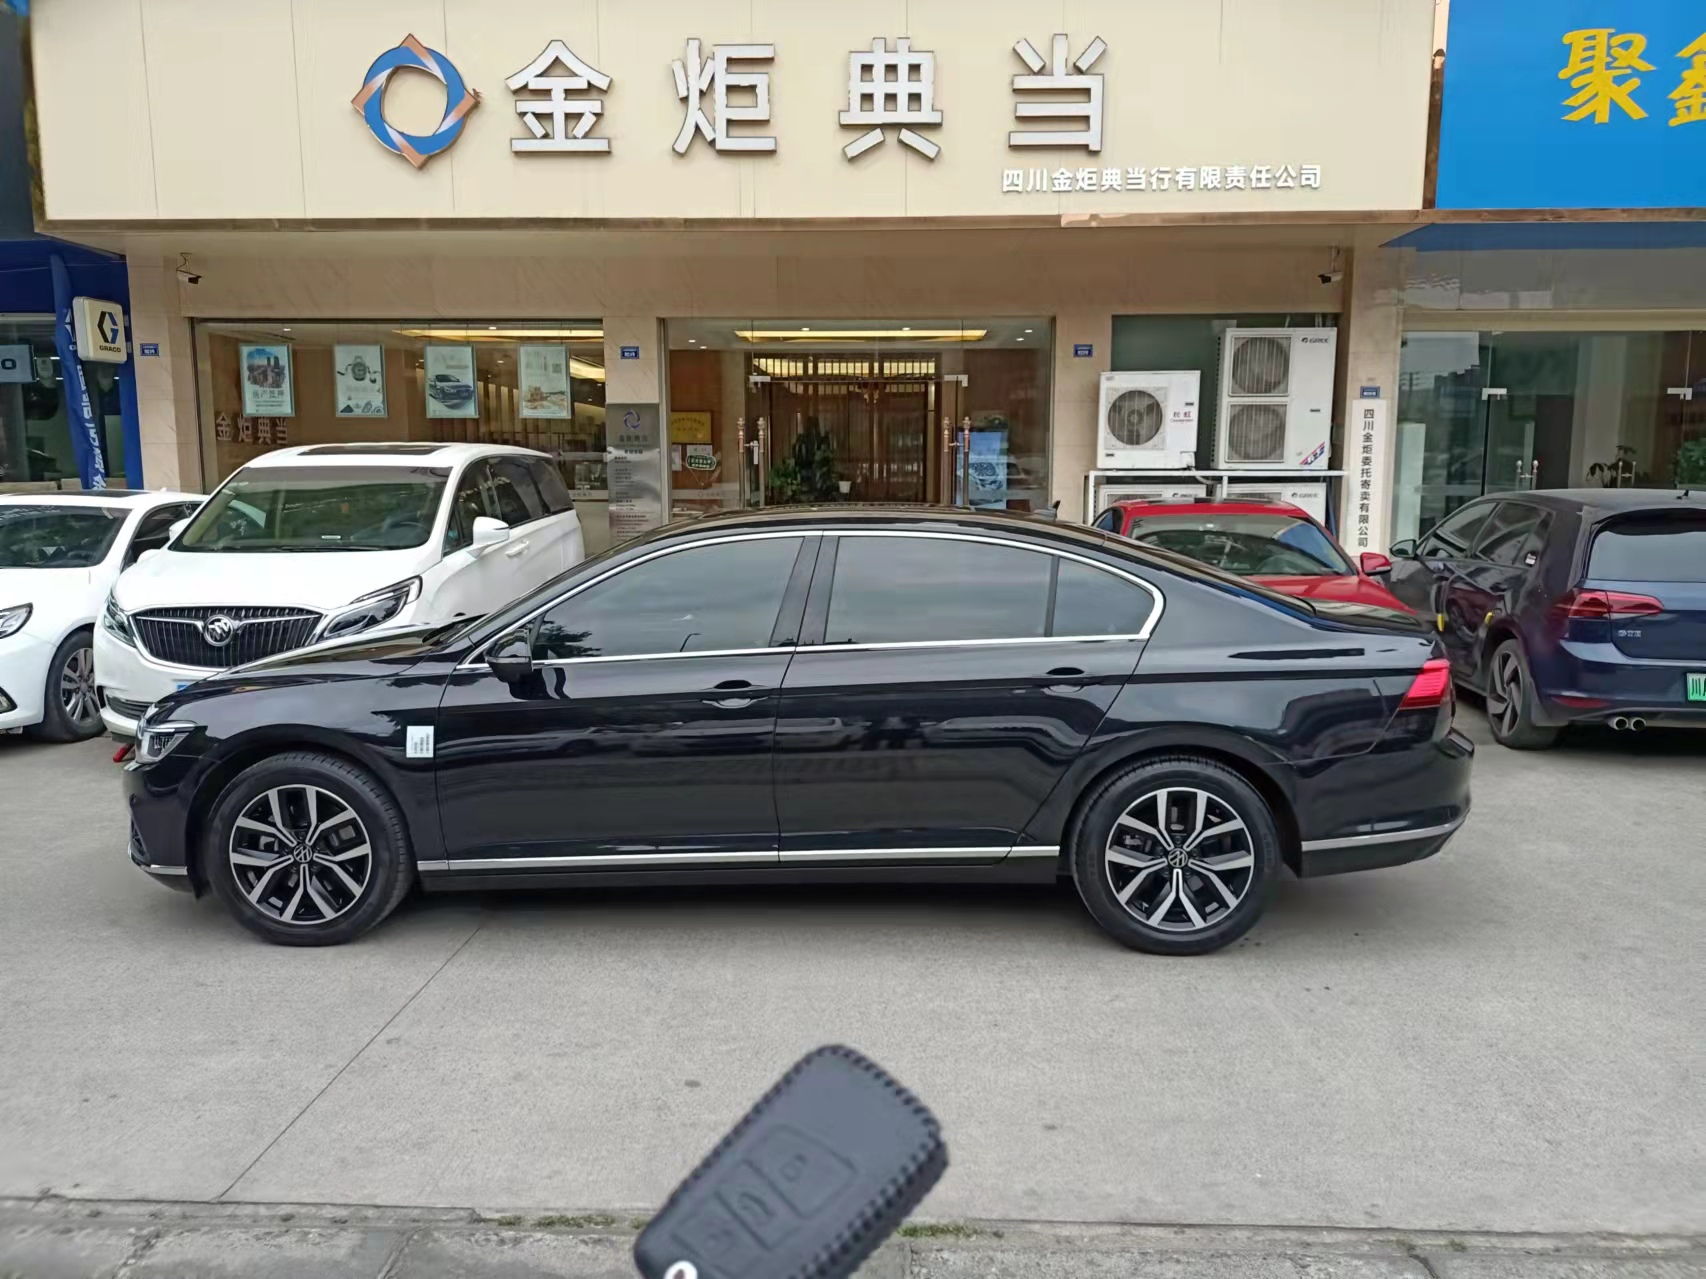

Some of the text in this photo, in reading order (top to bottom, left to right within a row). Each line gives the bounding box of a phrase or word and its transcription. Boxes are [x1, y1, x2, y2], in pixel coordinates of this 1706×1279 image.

[504, 33, 1108, 161] 金炬典当
[1001, 164, 1322, 193] 四川金炬典当行有限责任公司
[99, 345, 122, 353] GRACO
[216, 412, 288, 444] 金炬典当
[1357, 408, 1375, 548] 四川金炬委托寄卖有限公司
